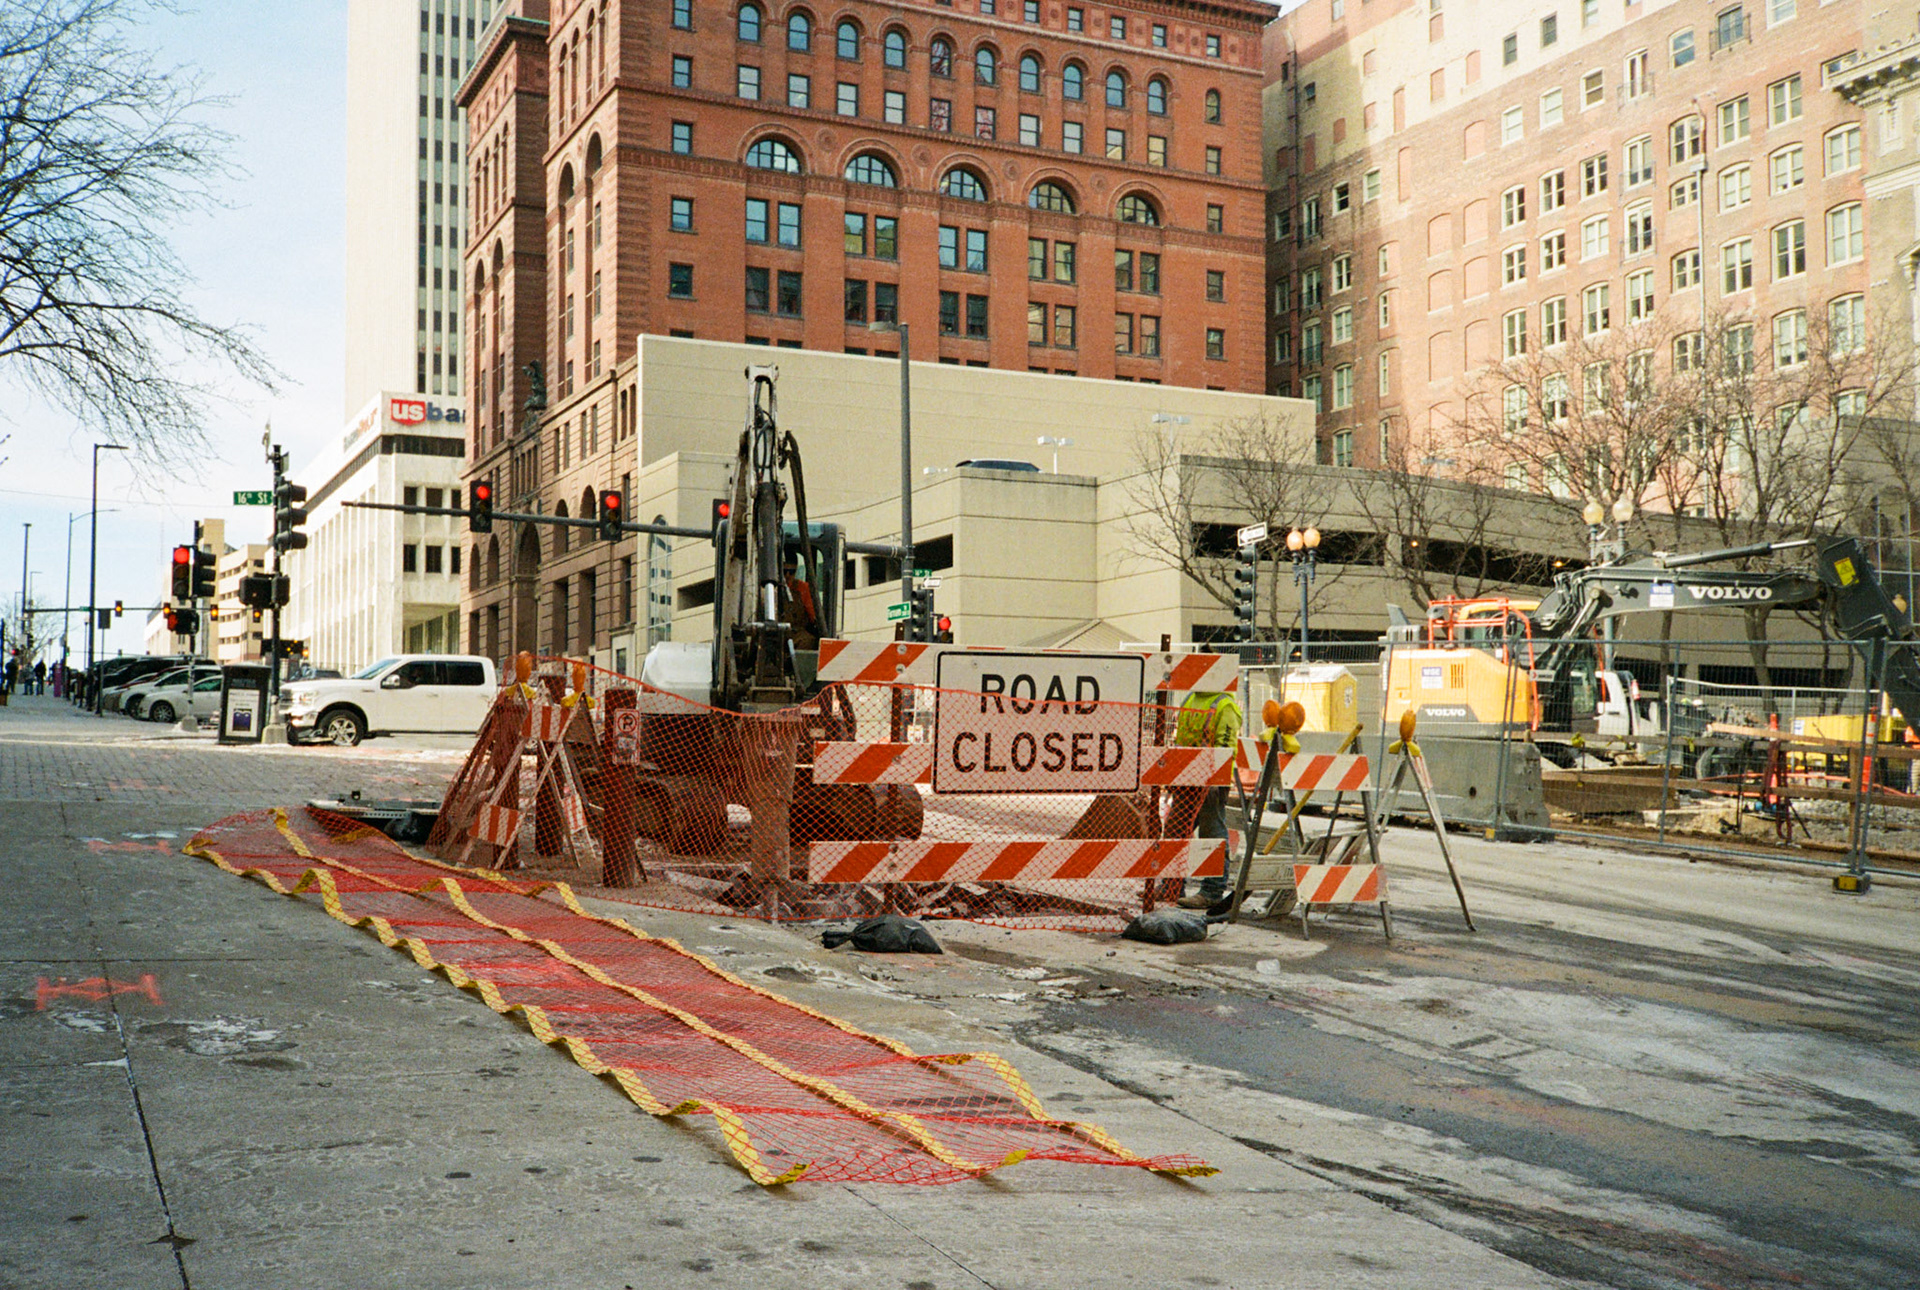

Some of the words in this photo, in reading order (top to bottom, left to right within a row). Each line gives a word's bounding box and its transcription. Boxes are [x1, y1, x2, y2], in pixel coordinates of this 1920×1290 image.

[237, 492, 252, 504] 16th
[257, 492, 268, 504] St
[1687, 586, 1773, 600] VOLVO
[980, 674, 1100, 715] ROAD
[1425, 708, 1466, 716] VOLVO
[952, 731, 1124, 773] CLOSED
